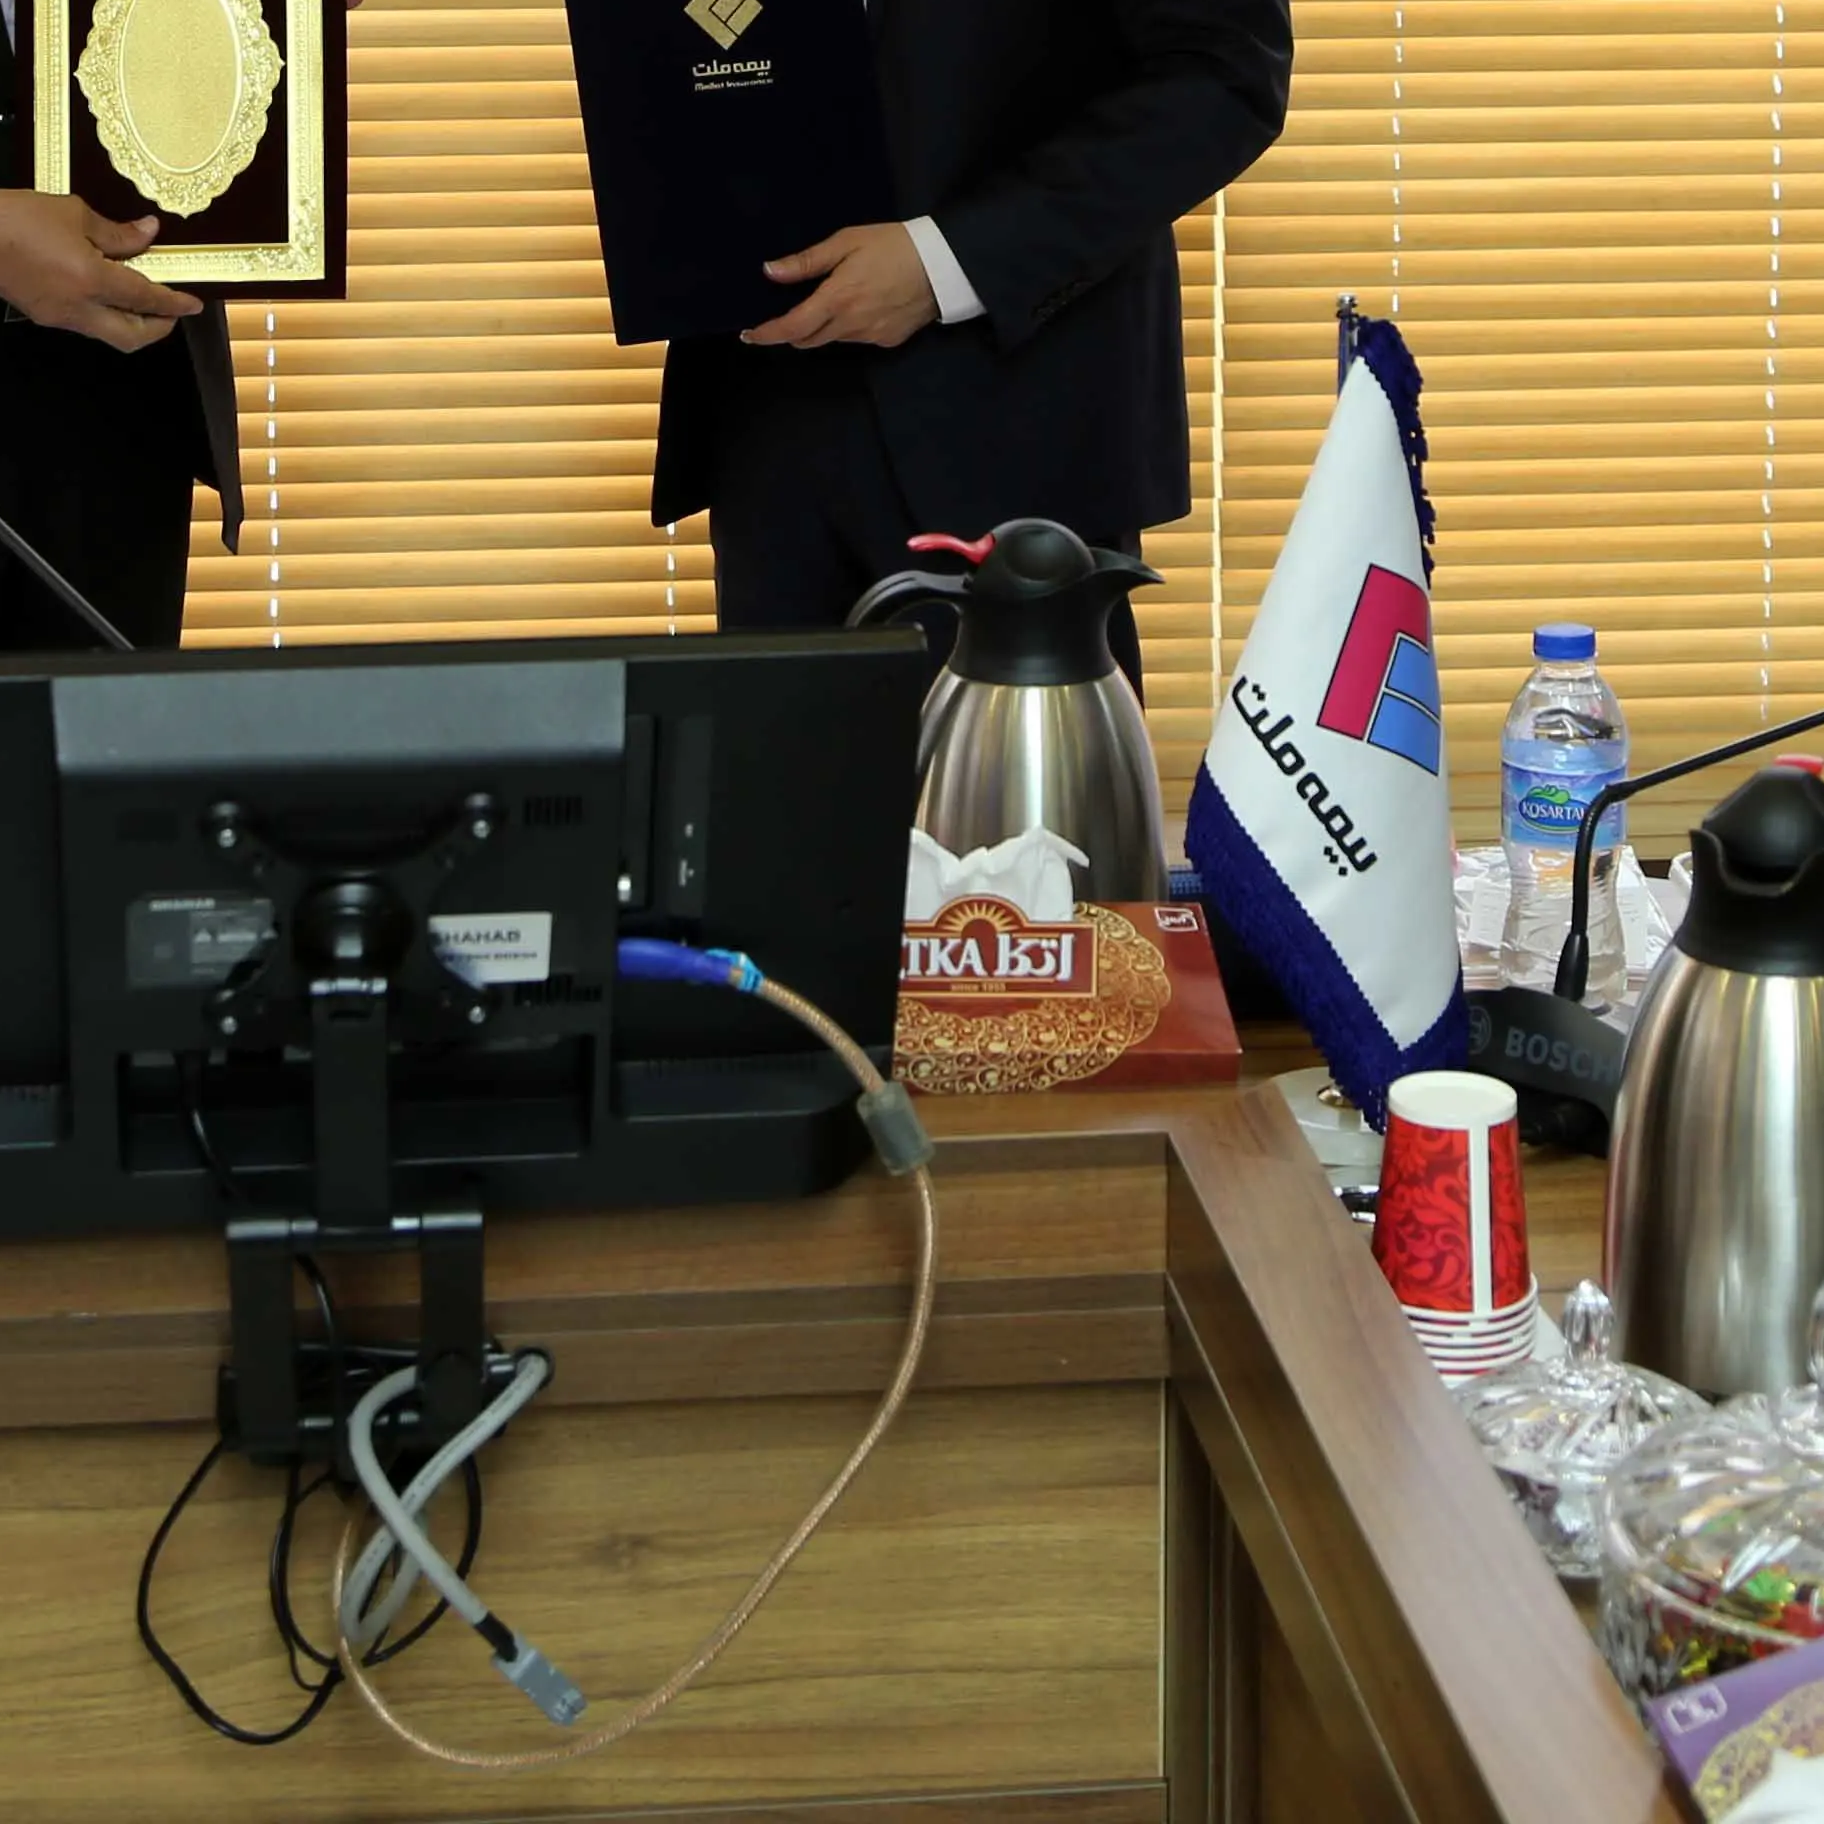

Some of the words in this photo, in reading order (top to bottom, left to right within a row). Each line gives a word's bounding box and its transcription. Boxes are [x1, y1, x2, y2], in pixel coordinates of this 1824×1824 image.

[692, 58, 732, 77] ملت
[732, 59, 772, 77] بیمه
[1231, 675, 1306, 776] ملت
[1295, 772, 1378, 876] بیمه
[994, 932, 1075, 982] اتکا
[1505, 1026, 1621, 1083] BOSCH
